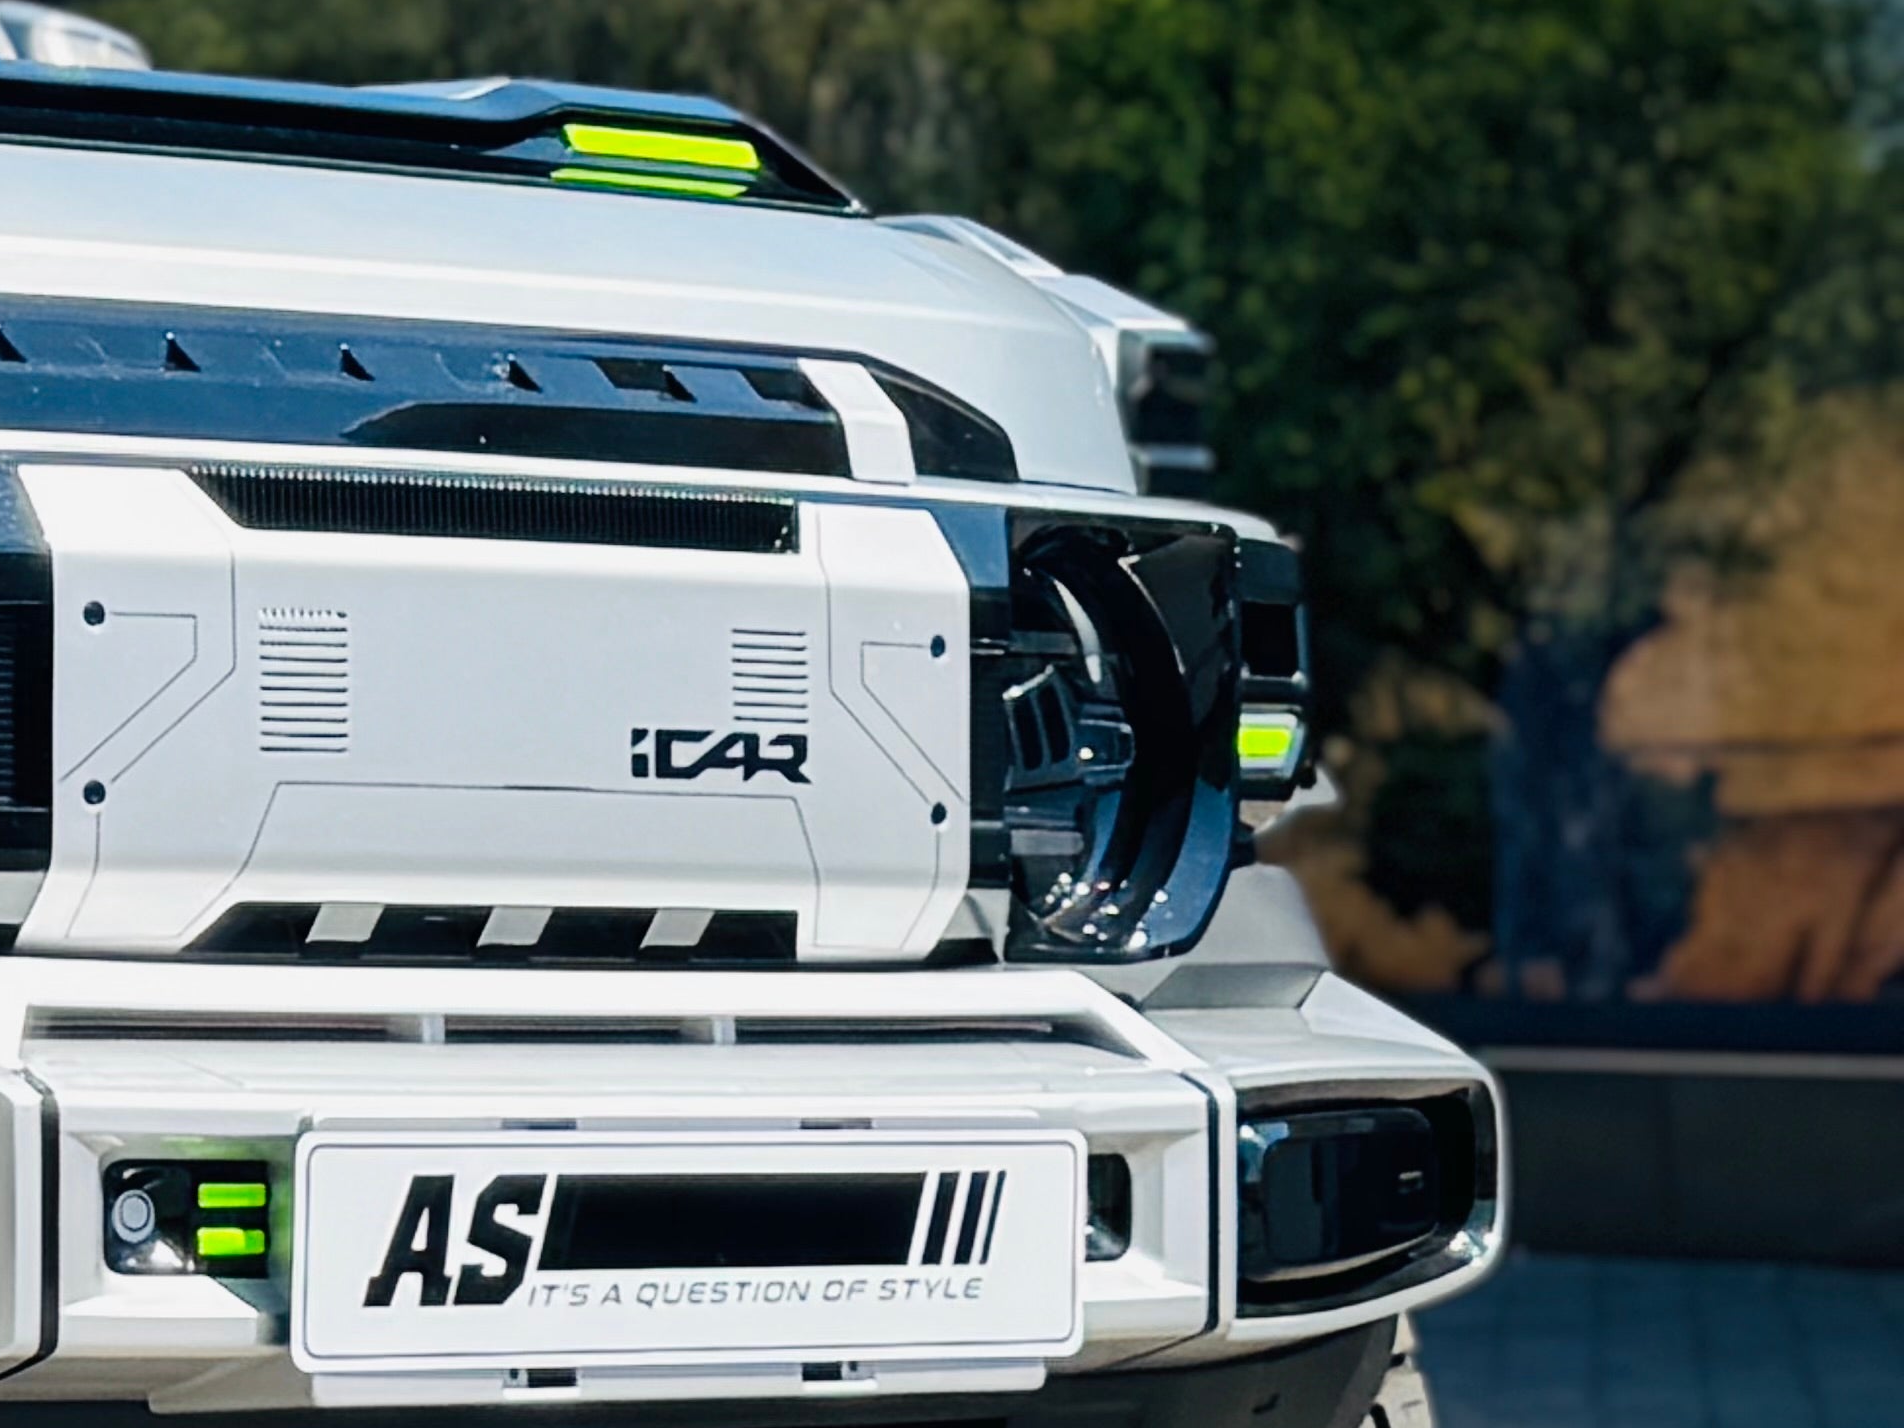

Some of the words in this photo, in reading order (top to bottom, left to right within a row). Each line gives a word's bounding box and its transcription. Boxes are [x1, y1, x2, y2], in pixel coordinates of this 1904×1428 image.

[362, 1173, 548, 1307] AS
[527, 1282, 591, 1307] IT'S
[600, 1283, 622, 1306] A
[635, 1280, 811, 1309] QUESTION
[821, 1279, 869, 1303] OF
[877, 1277, 984, 1301] STYLE
